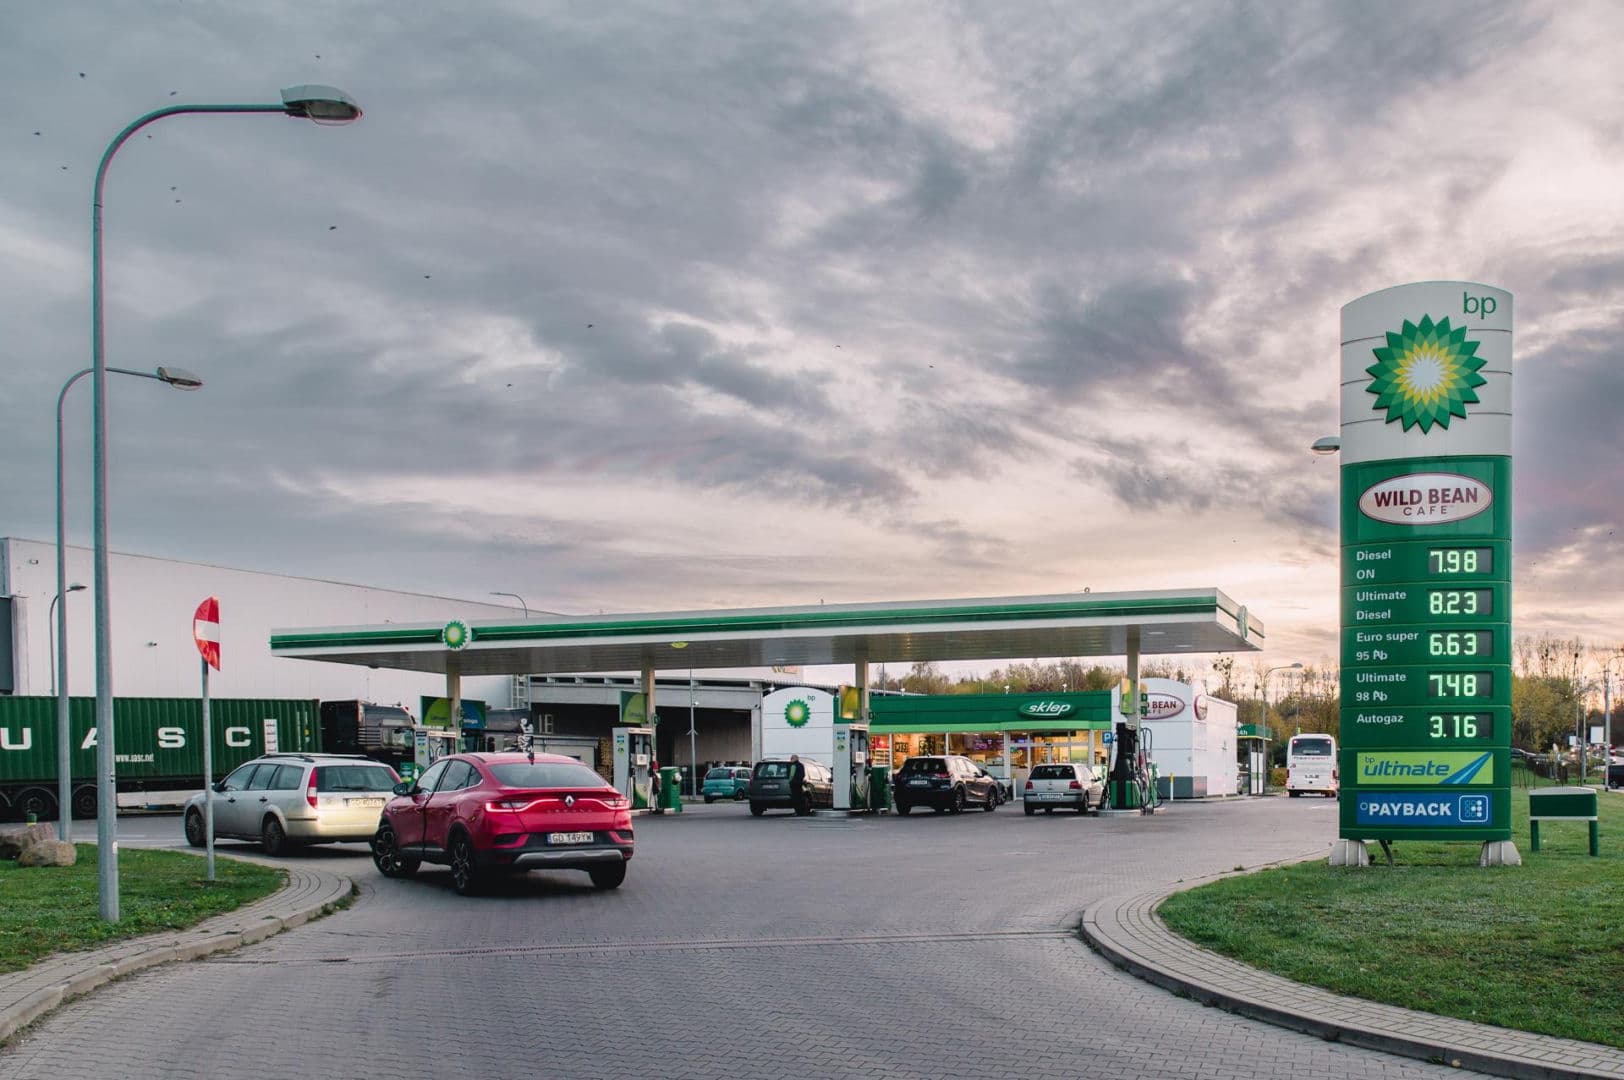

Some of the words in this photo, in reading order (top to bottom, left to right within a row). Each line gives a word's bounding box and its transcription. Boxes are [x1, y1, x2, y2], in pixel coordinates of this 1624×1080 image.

[1463, 291, 1497, 320] bp
[1374, 489, 1422, 507] WILD
[1428, 487, 1478, 504] BEAN
[1403, 505, 1448, 516] CAFE
[1356, 549, 1392, 561] Diesel
[1430, 550, 1477, 573] 7.98
[1356, 569, 1375, 580] ON
[1356, 591, 1407, 602] Ultimate
[1430, 591, 1477, 615] 8.23
[1356, 609, 1391, 620] Diesel
[1356, 632, 1383, 642] Euro
[1386, 632, 1419, 643] super
[1430, 633, 1477, 656] 6.63
[1356, 651, 1370, 661] 95
[1356, 673, 1407, 683] Ultimate
[1430, 674, 1477, 697] 7.48
[1356, 691, 1370, 701] 98
[1027, 701, 1071, 716] sklep
[1152, 701, 1177, 709] BEAN
[1356, 714, 1404, 725] Autogaz
[1430, 715, 1477, 738] 3.16
[1364, 760, 1450, 777] ultimate
[1369, 802, 1452, 816] PAYBACK
